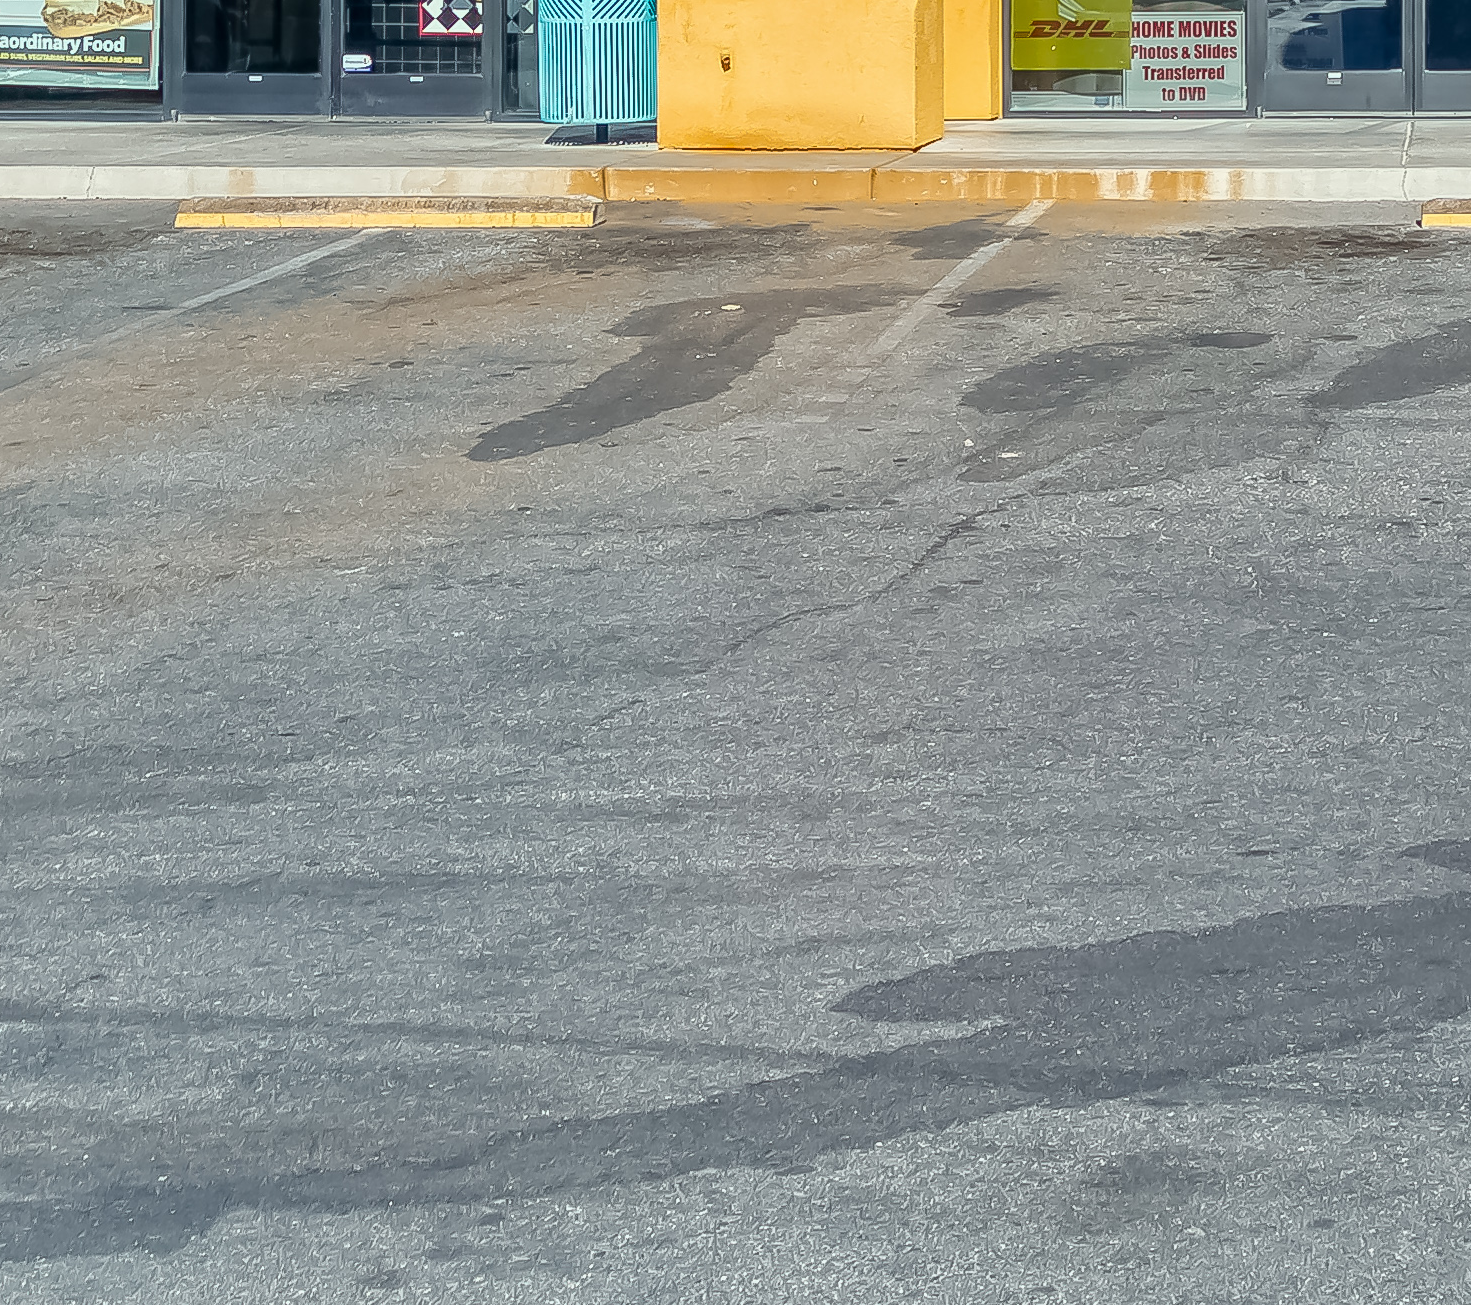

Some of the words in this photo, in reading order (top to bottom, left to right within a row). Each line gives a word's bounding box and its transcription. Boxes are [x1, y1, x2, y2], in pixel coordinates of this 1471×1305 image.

[1030, 19, 1111, 39] DHL
[1130, 20, 1175, 39] HOME
[1177, 20, 1238, 39] MOVIES
[82, 35, 126, 54] Food
[1130, 43, 1179, 60] Photos
[1181, 44, 1192, 60] &
[1193, 43, 1238, 60] Slides
[1142, 65, 1225, 81] Transferred
[1161, 87, 1176, 102] to
[1178, 87, 1206, 102] DVD
